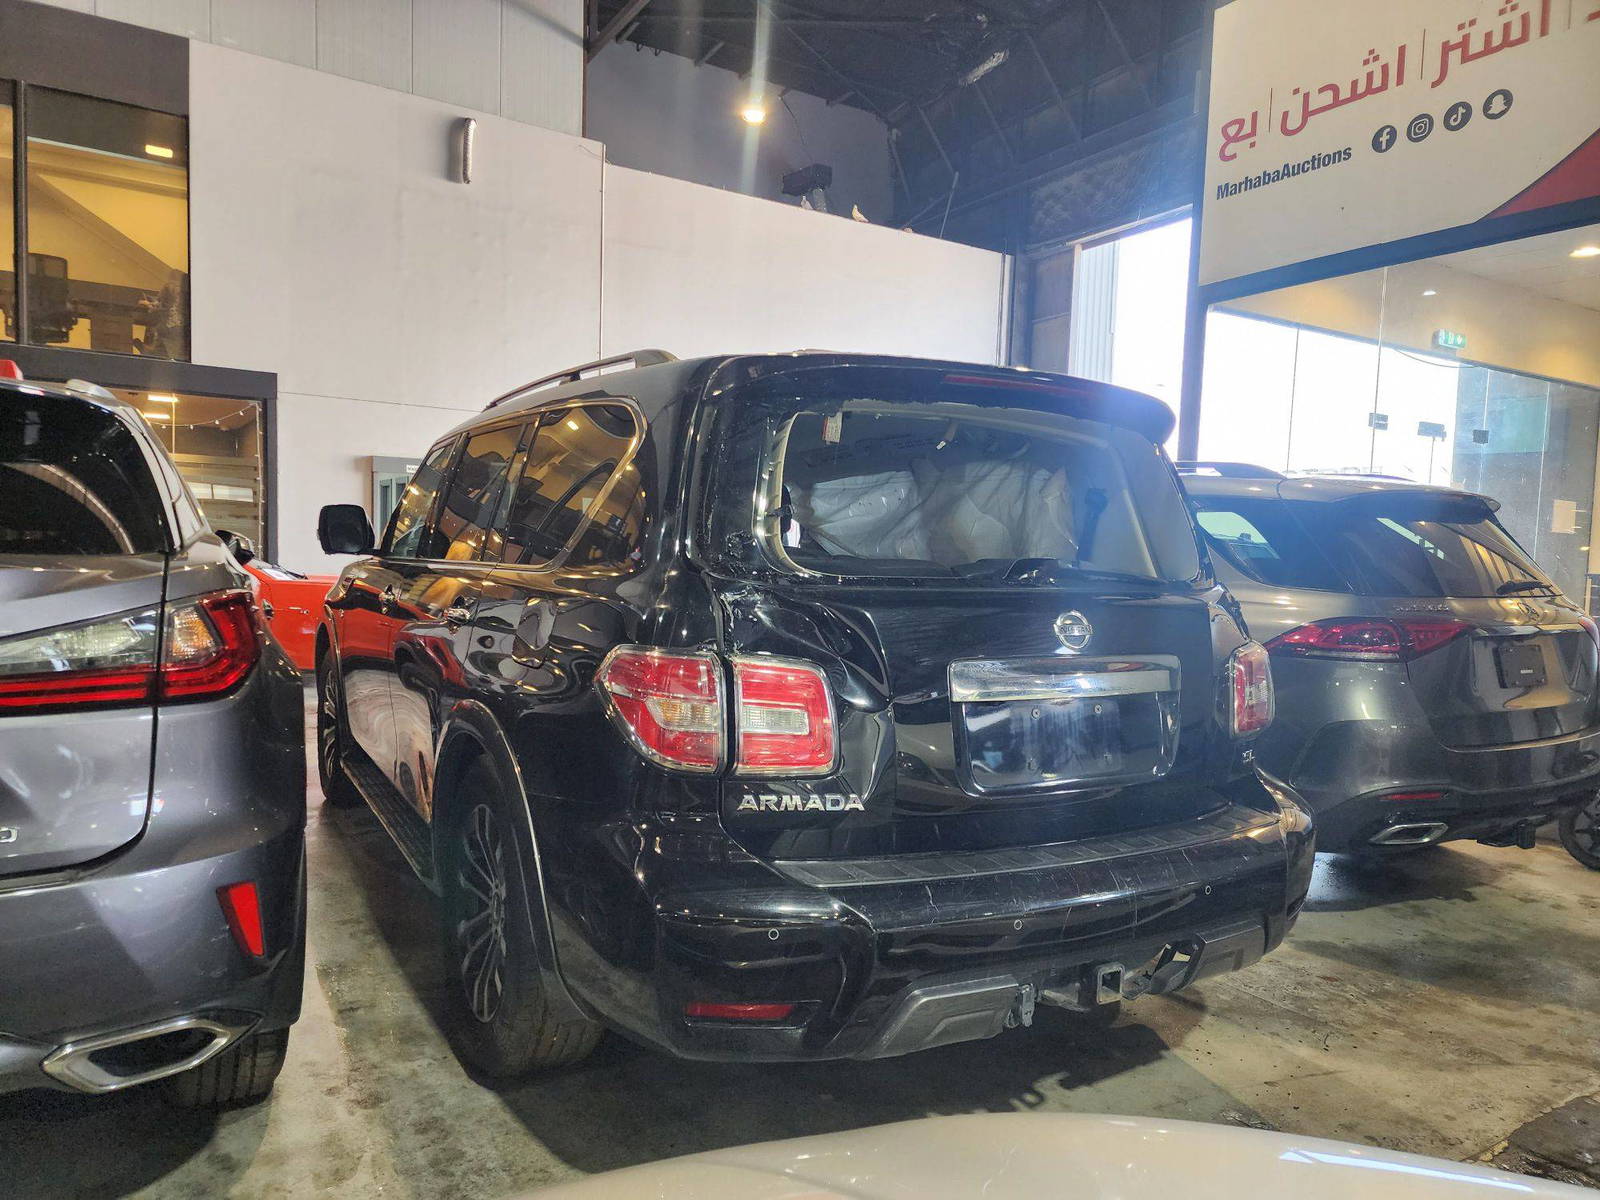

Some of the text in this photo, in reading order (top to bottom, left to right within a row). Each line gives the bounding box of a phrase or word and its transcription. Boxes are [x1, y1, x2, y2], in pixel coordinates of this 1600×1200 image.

[1280, 44, 1407, 137] اشحن
[1218, 110, 1258, 162] بع
[1216, 146, 1353, 201] MarhabaAuctions
[737, 793, 866, 812] ARMADA
